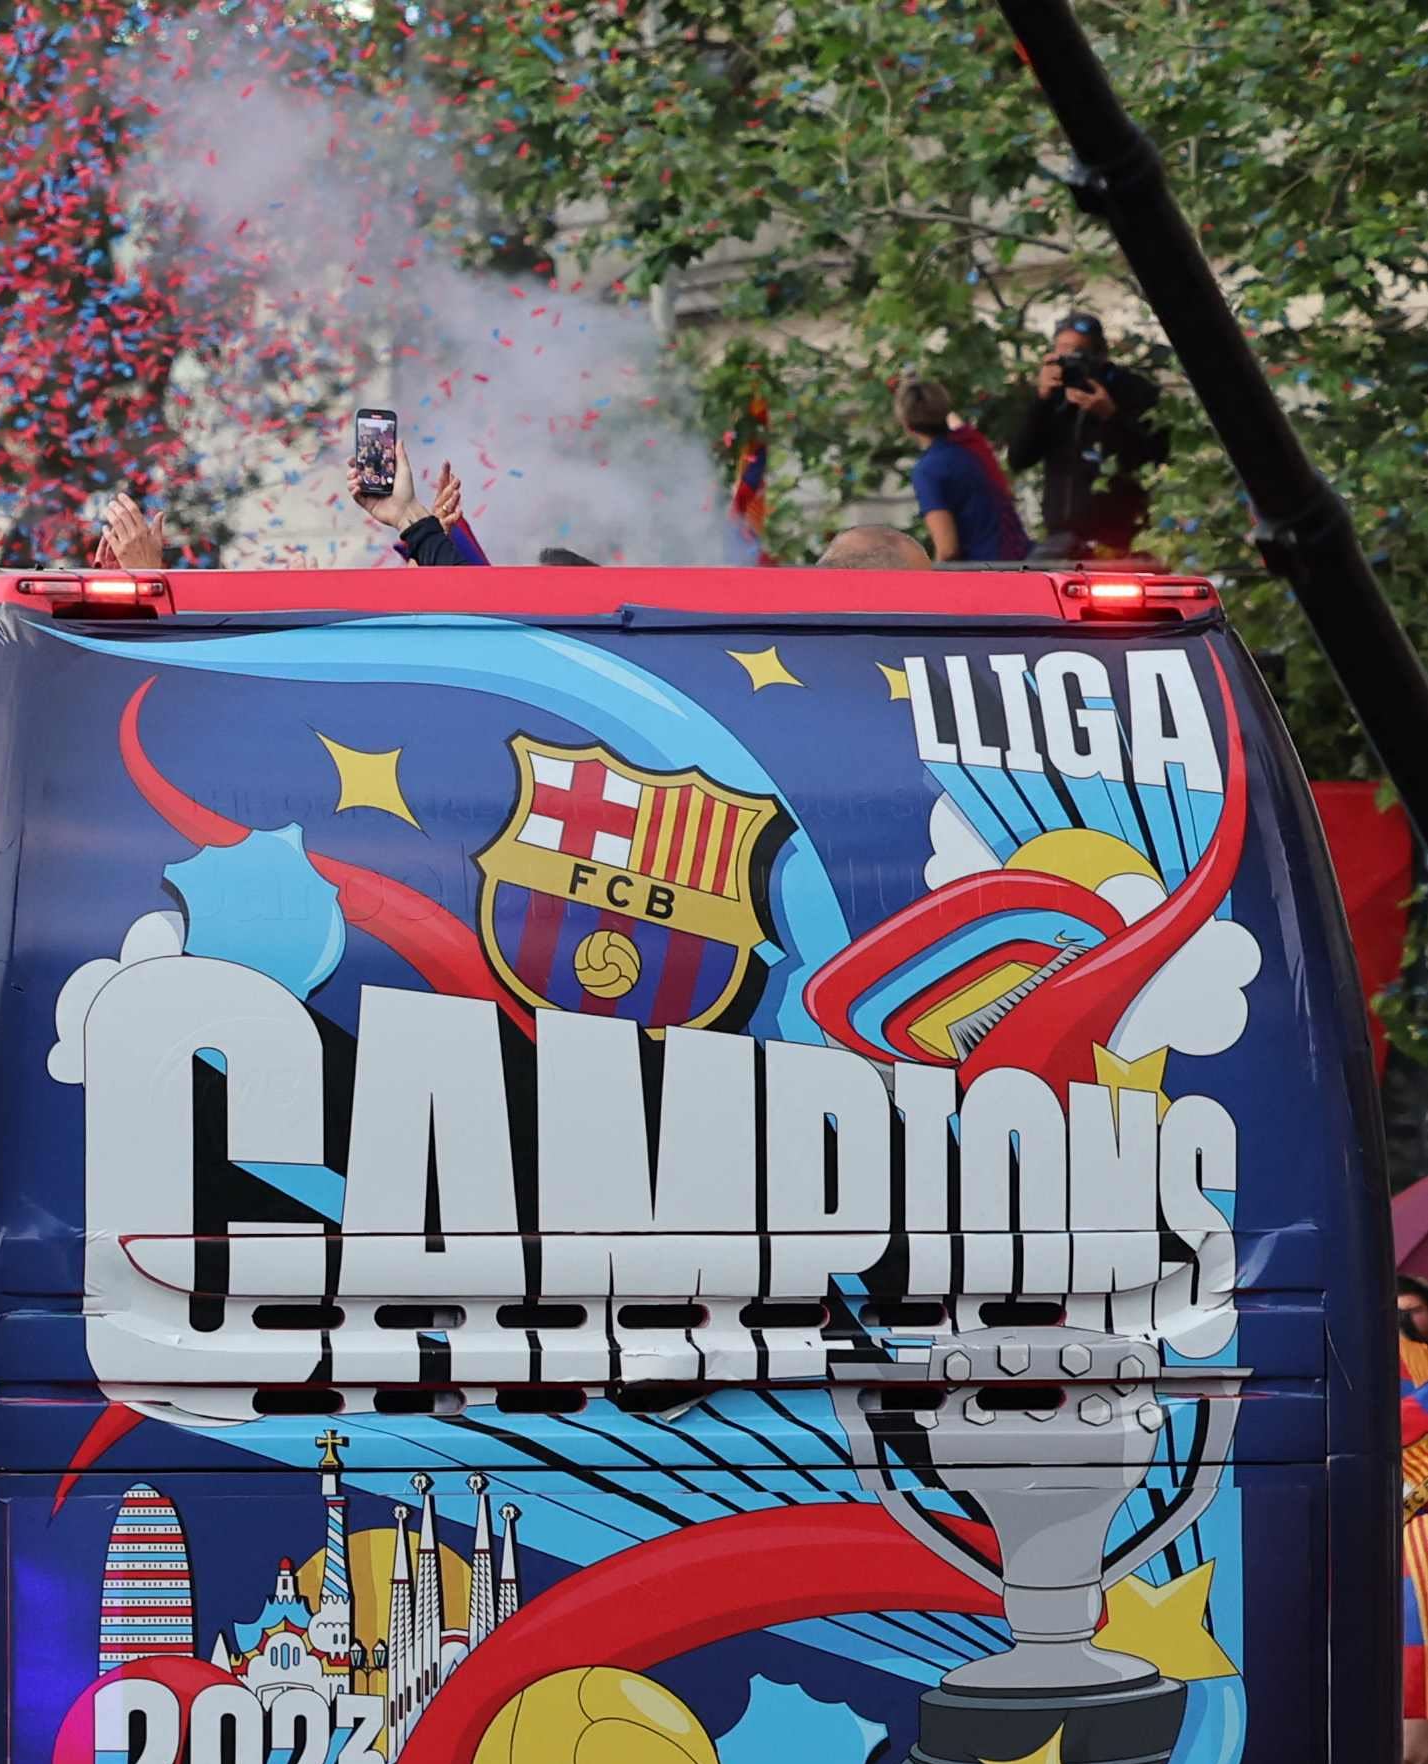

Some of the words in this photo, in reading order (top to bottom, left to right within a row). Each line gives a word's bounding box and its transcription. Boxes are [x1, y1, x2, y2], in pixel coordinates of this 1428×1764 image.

[902, 648, 1223, 793] LLIGA
[569, 863, 675, 919] FCB
[84, 955, 1237, 1422] CAMPIONS
